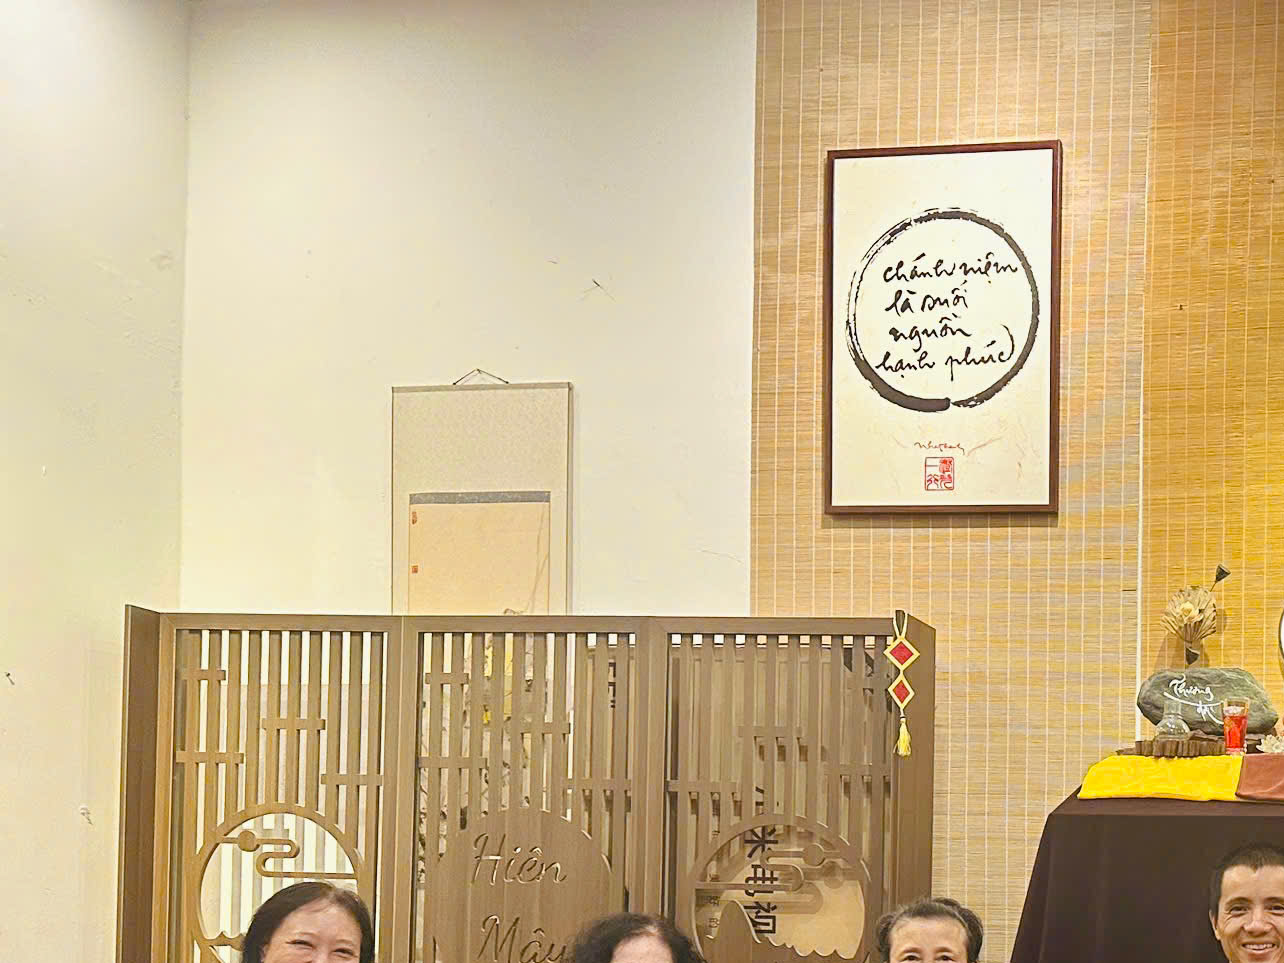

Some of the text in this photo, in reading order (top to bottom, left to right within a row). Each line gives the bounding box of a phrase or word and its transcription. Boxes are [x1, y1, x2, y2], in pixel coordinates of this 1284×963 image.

[884, 252, 1018, 285] chánh niệm
[885, 280, 969, 317] là suối
[889, 313, 973, 352] nguồn
[875, 324, 1014, 381] hạnh phúc
[472, 833, 568, 886] Hiên
